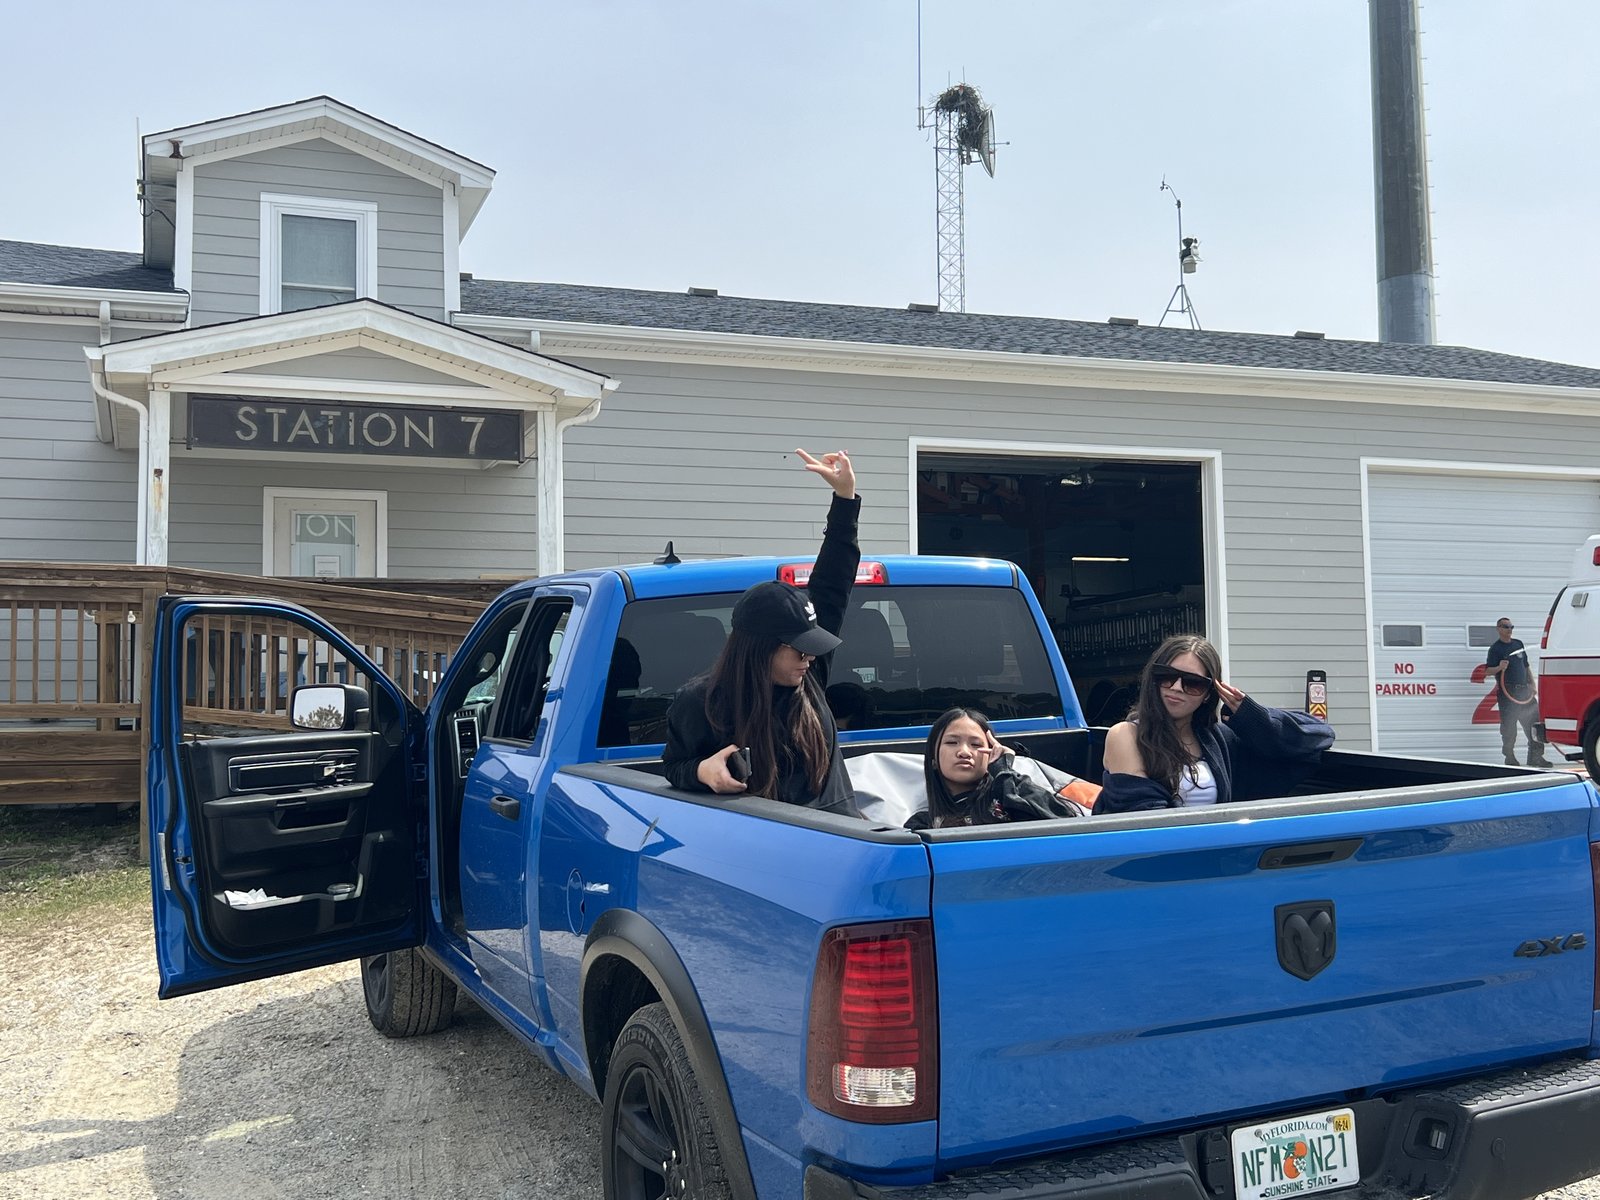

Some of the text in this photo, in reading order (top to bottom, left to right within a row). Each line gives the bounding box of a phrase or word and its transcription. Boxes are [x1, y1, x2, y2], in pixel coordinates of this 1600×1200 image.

[234, 405, 485, 455] STATION 7
[1394, 663, 1414, 674] NO
[1375, 683, 1437, 695] PARKING
[1241, 1132, 1348, 1188] NFM N21
[1265, 1175, 1333, 1198] SUNSHINE STATE
